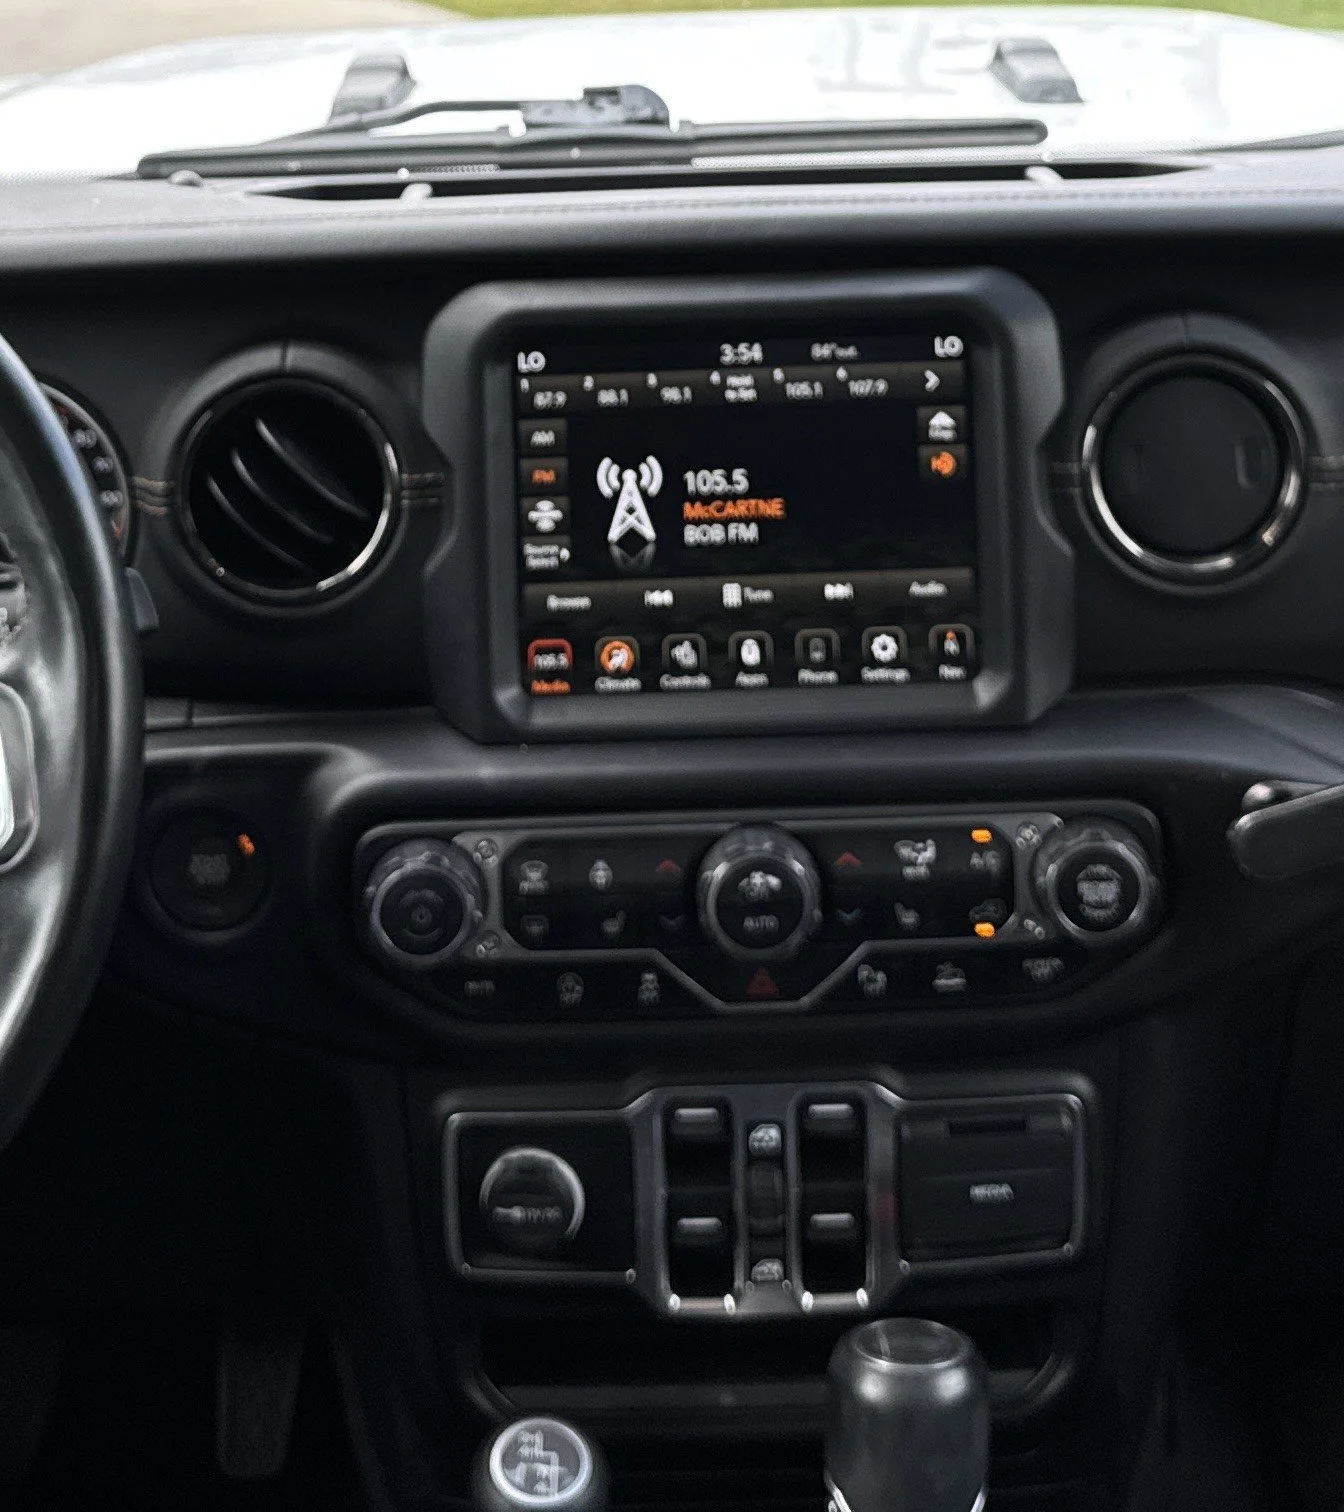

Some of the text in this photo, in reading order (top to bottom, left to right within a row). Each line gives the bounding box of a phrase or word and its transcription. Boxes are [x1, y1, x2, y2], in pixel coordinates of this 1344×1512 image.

[719, 341, 764, 366] 3:54
[933, 334, 964, 358] LO
[517, 349, 547, 374] LO
[683, 466, 749, 497] 105.5
[727, 521, 759, 546] FM
